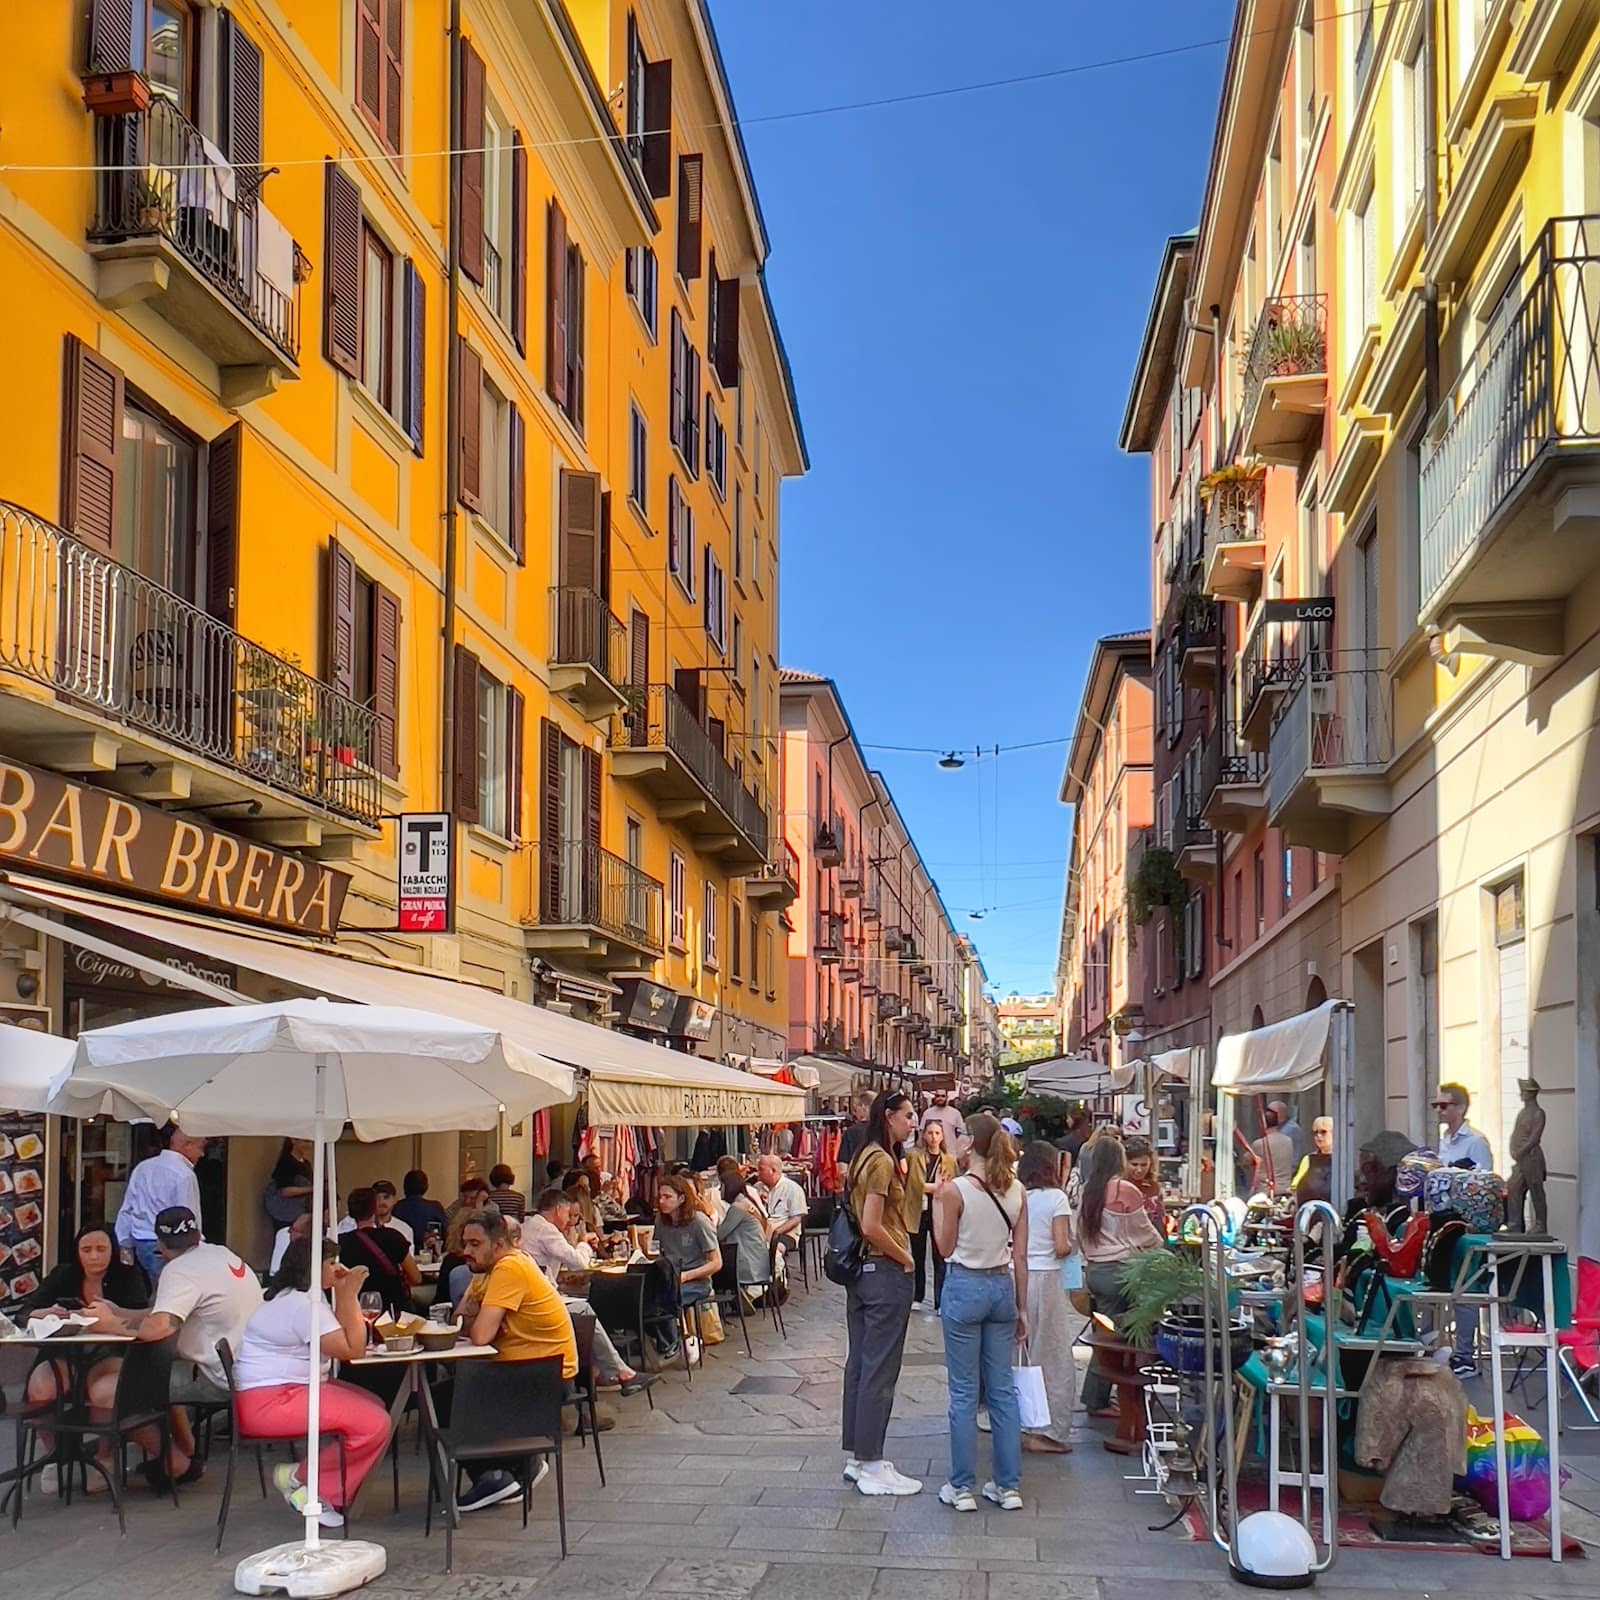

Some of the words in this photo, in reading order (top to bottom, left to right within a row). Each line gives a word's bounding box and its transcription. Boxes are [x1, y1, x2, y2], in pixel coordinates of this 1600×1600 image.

[1296, 606, 1333, 618] LAGO
[0, 764, 142, 882] BAR
[160, 819, 334, 932] BRERA
[407, 821, 444, 872] T
[402, 875, 446, 885] TABACCHI
[75, 947, 135, 985] Cigars
